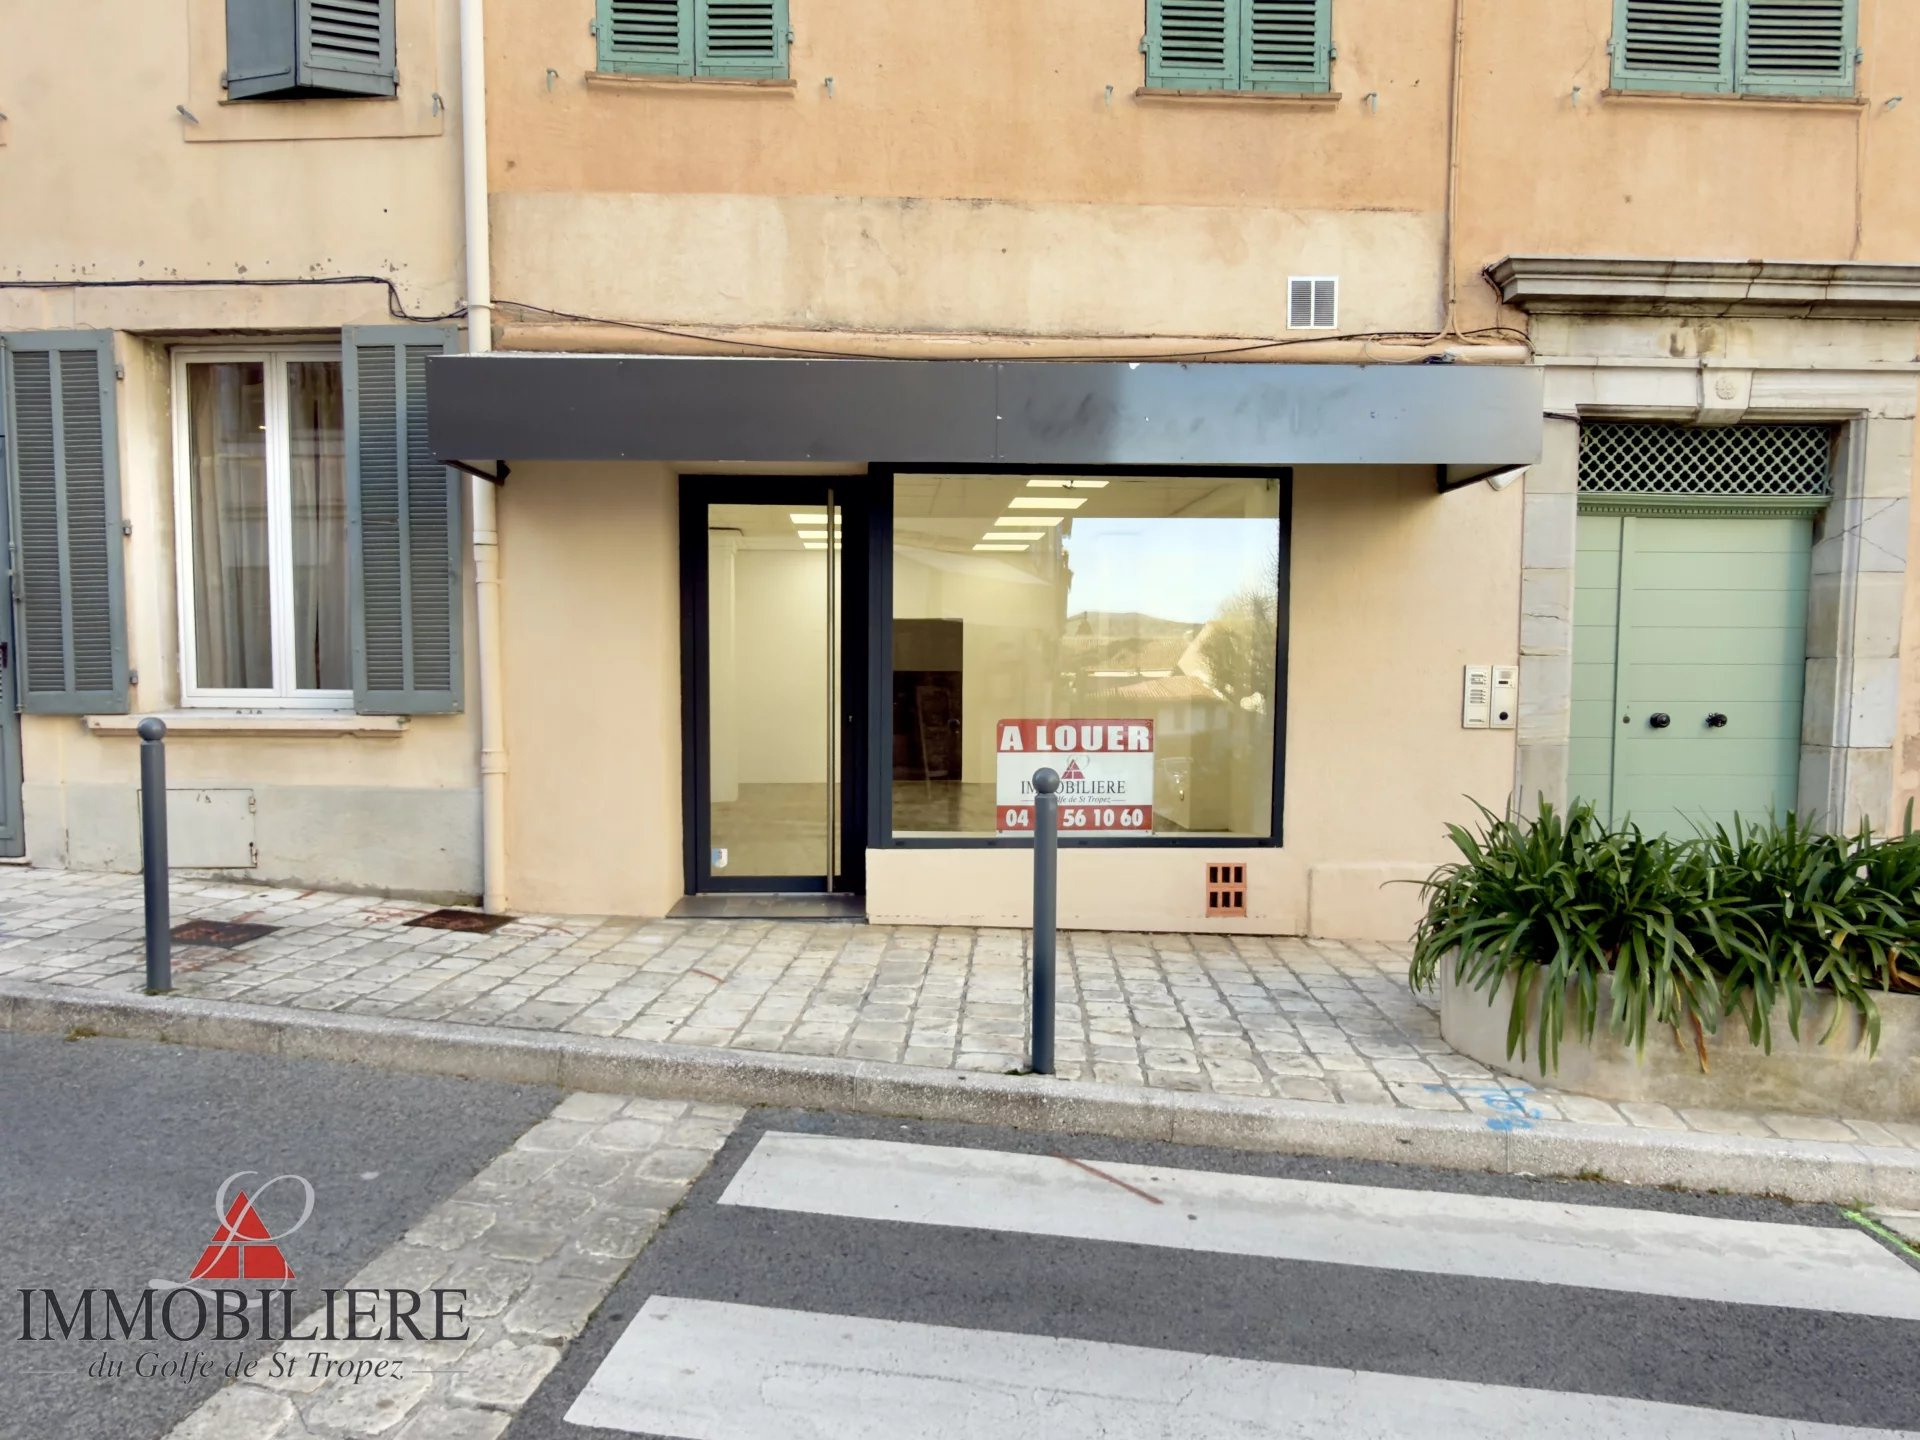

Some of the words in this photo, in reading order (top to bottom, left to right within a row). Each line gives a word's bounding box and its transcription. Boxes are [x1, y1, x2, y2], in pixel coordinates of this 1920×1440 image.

[1000, 725, 1024, 751] A
[1036, 725, 1150, 751] LOUER
[1021, 780, 1126, 795] IMOBILIERE
[1088, 796, 1111, 804] Tropez
[1005, 809, 1029, 827] 04
[1063, 809, 1087, 827] 56
[1094, 809, 1115, 827] 10
[1120, 809, 1144, 827] 60
